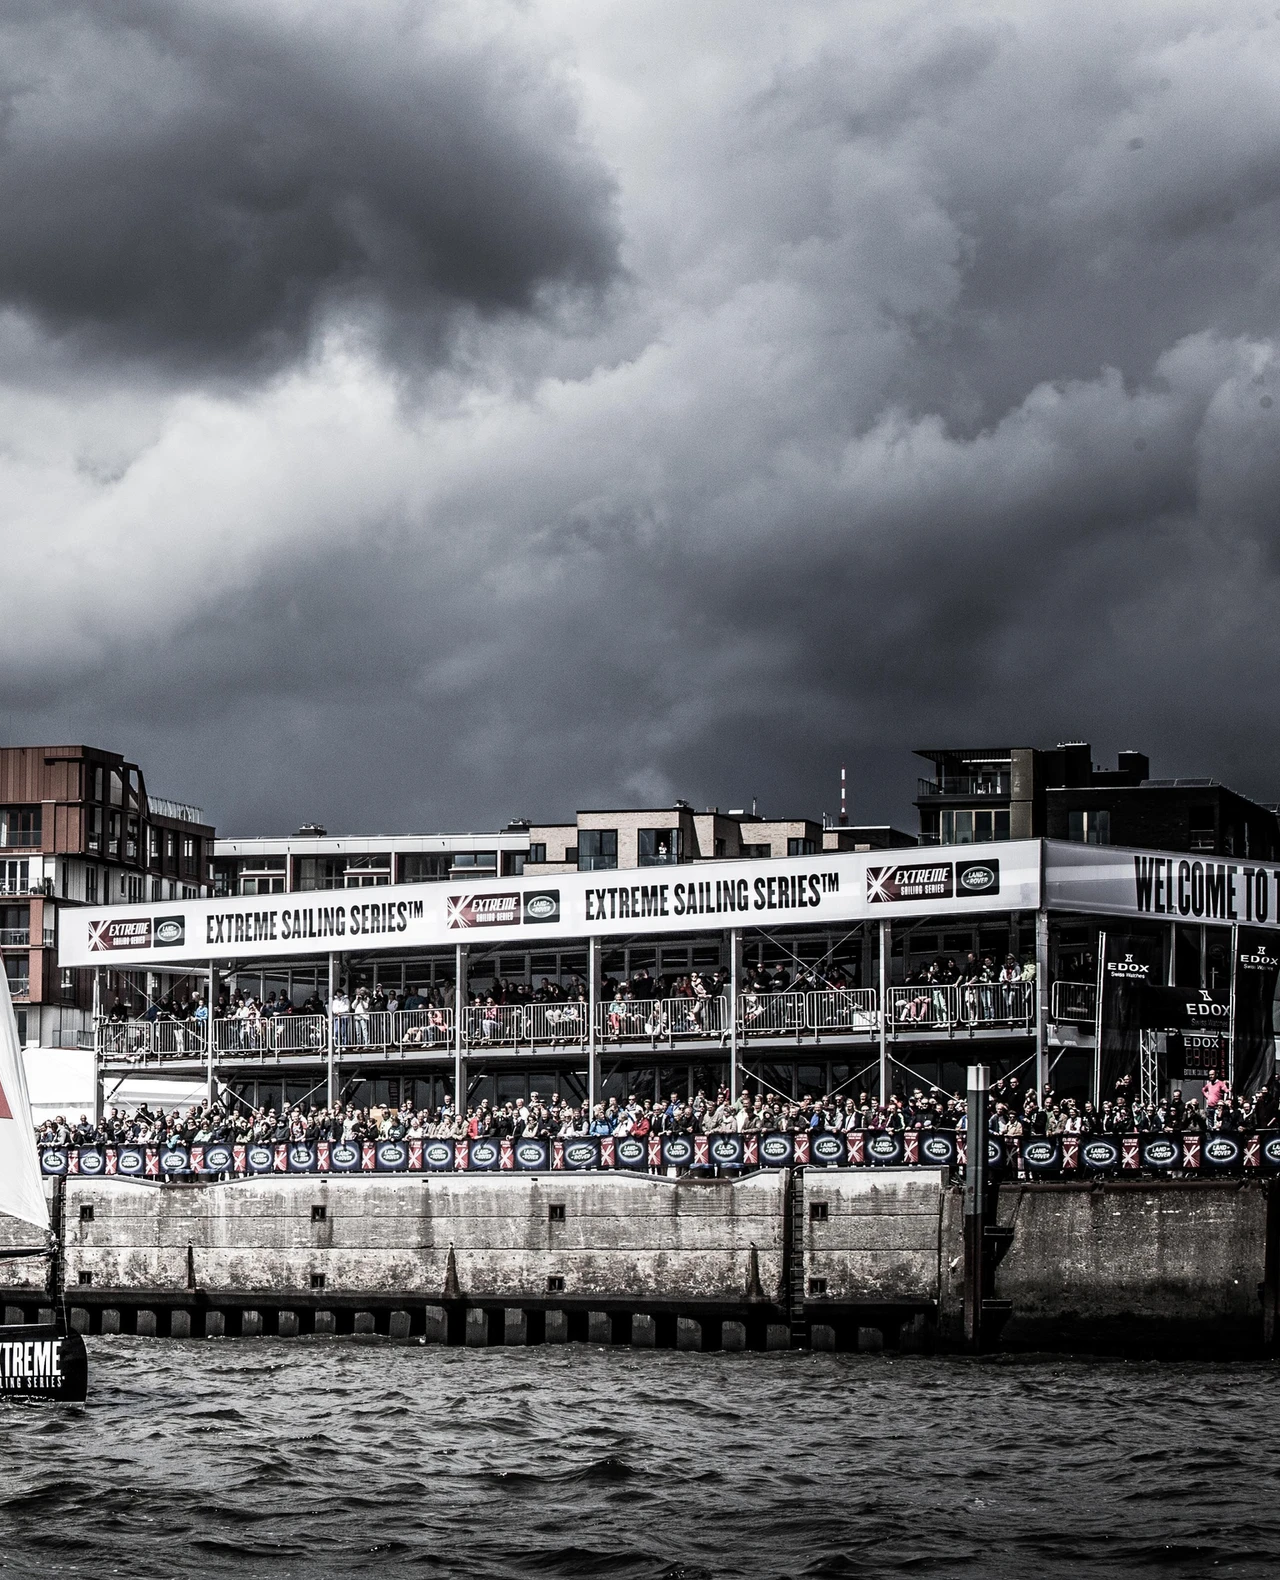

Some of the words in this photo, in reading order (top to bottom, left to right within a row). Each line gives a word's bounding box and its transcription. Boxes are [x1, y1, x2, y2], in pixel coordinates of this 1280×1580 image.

[894, 867, 950, 885] EXTREME
[969, 877, 988, 885] ROVER
[925, 884, 944, 894] SERIES
[1134, 856, 1238, 920] WELCOME
[1243, 867, 1268, 923] TO
[471, 897, 518, 912] EXTREME
[585, 885, 669, 921] EXTREME
[674, 879, 749, 915] SAILING
[109, 922, 150, 936] EXTREME
[206, 911, 277, 944] EXTREME
[281, 906, 346, 939] SAILING
[1240, 954, 1279, 965] EDOX
[1107, 962, 1149, 972] EDOX
[1186, 1003, 1230, 1016] EDOX
[1184, 1037, 1219, 1048] EDOX
